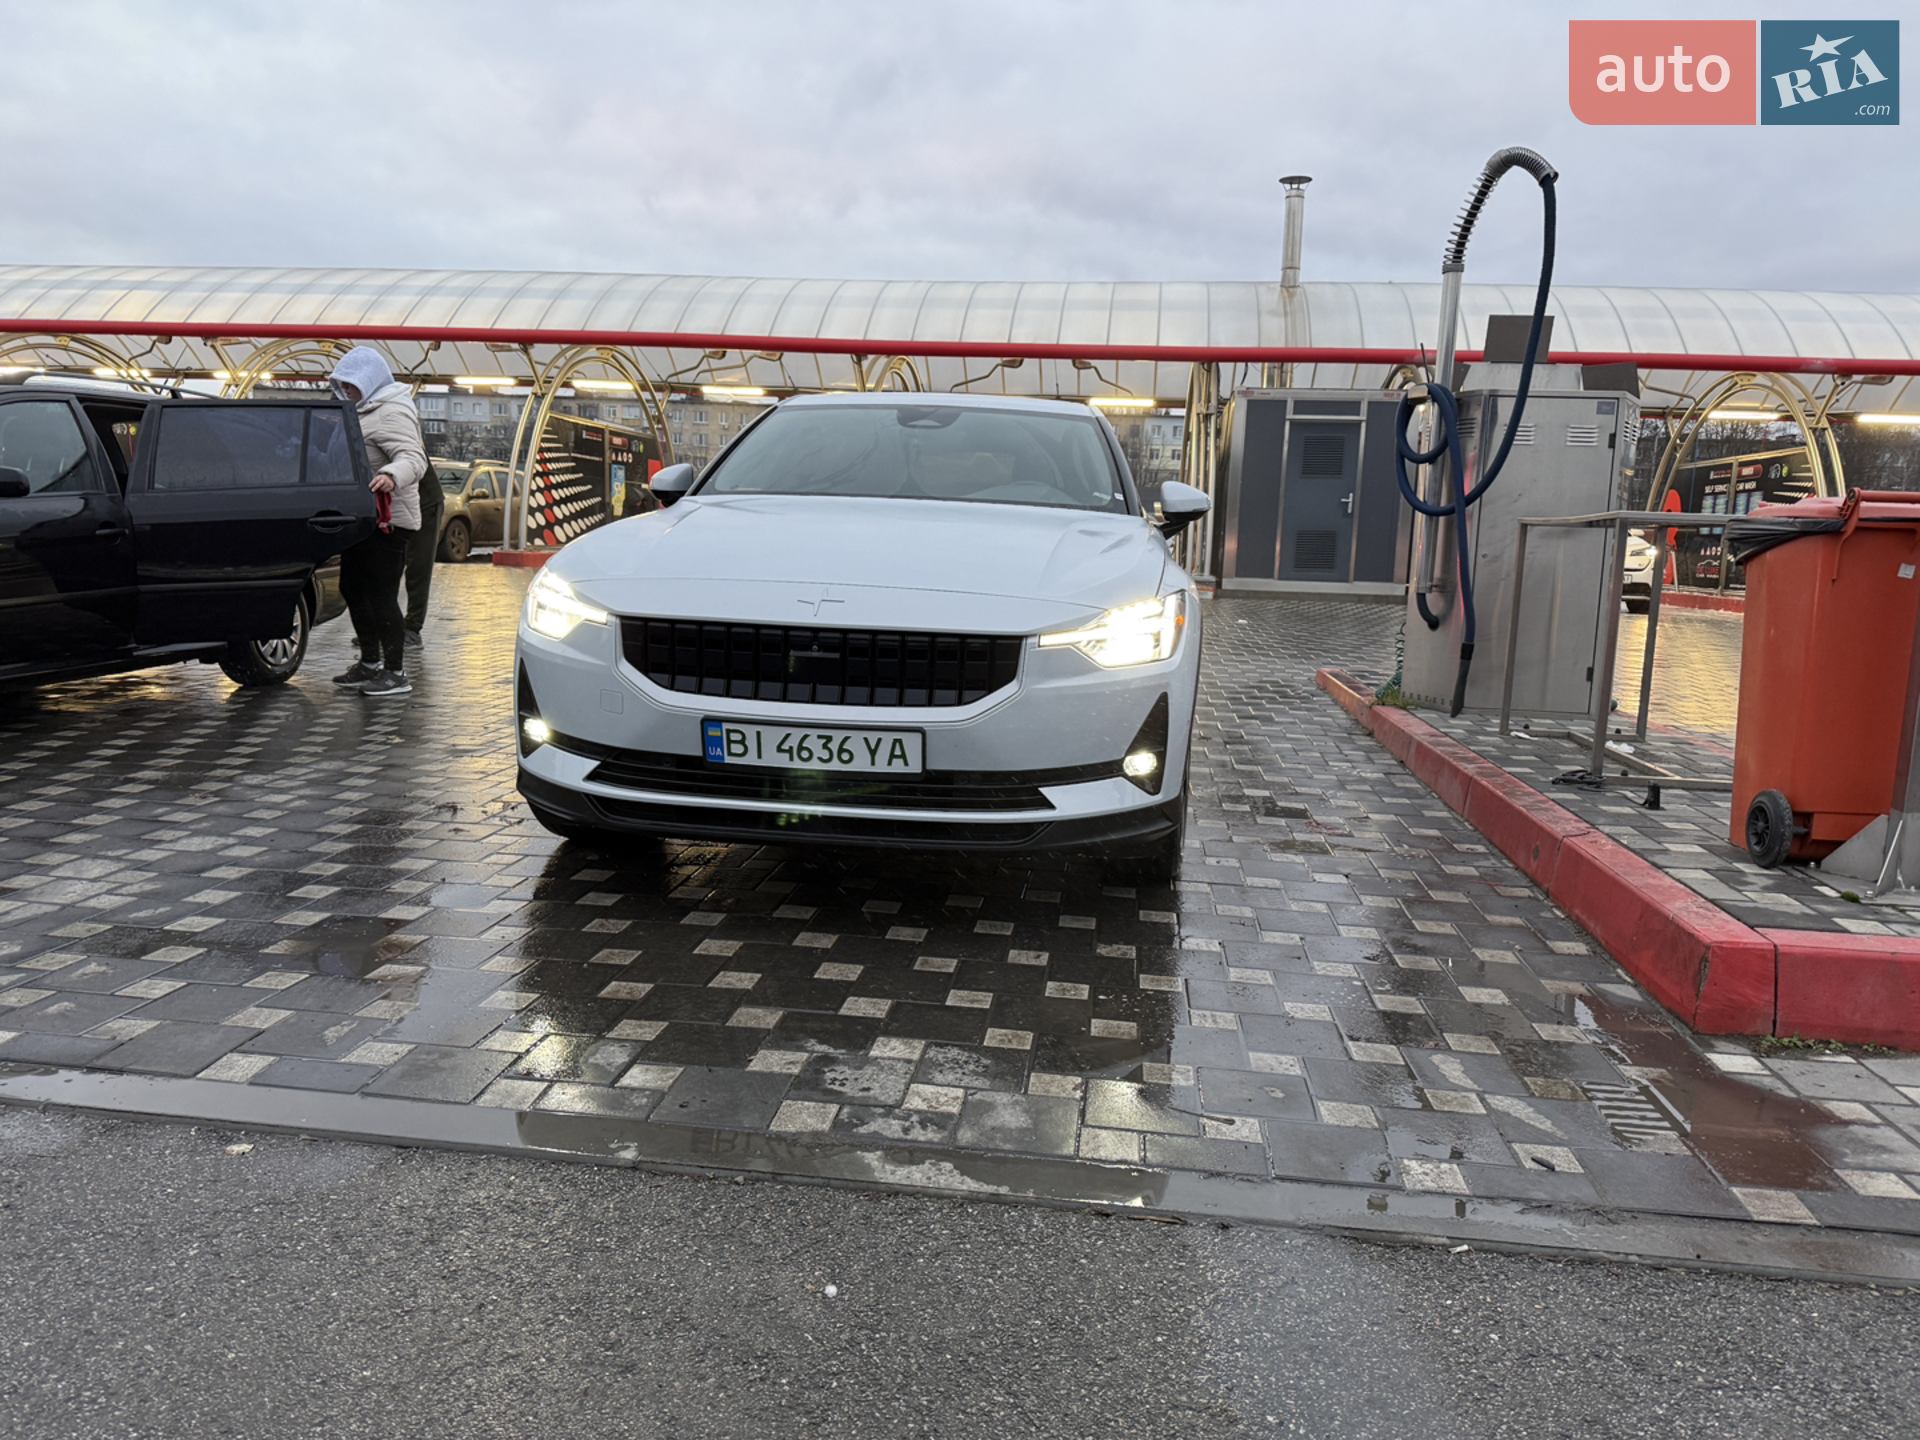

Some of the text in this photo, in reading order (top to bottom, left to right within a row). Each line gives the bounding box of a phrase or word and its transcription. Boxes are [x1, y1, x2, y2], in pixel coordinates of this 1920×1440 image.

[708, 747, 723, 757] UA
[725, 728, 909, 767] BI 4636 YA
